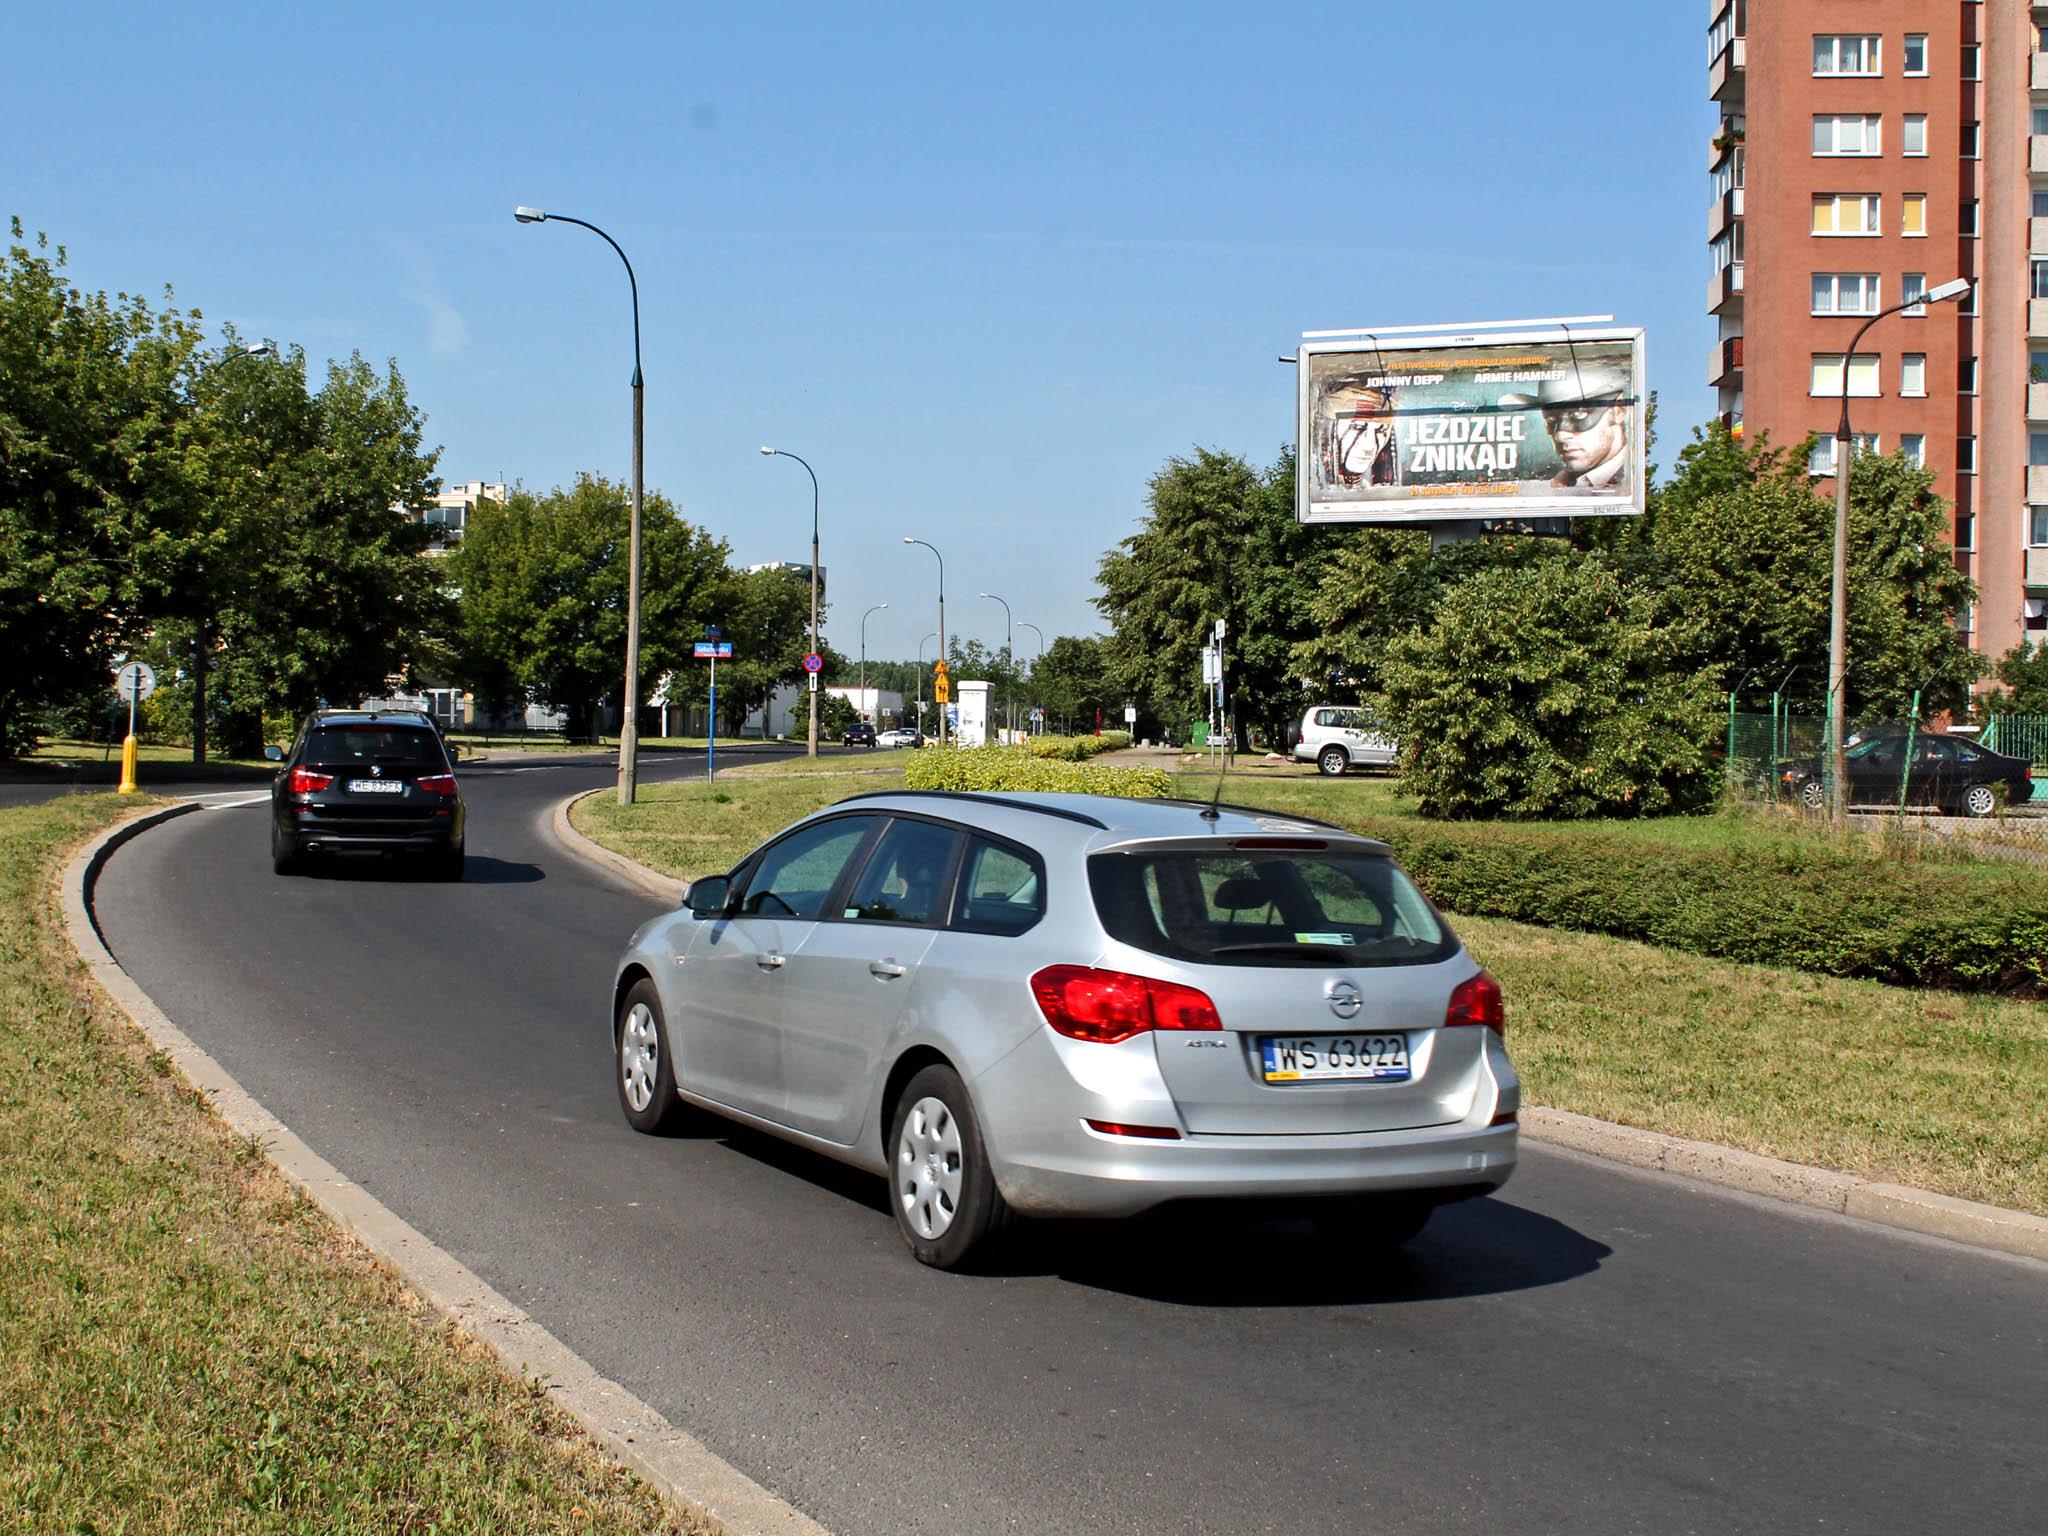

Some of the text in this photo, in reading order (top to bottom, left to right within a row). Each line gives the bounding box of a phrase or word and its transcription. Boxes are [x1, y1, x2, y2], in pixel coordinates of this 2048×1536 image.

[1366, 375, 1444, 387] JOHNNY DEPP
[1474, 370, 1566, 383] ARMIE HAMMER
[1404, 414, 1525, 445] JEŹDZIEC
[1410, 443, 1518, 477] ZNIKĄD
[1184, 1040, 1227, 1049] ASTRA
[1279, 1038, 1403, 1070] WS 63622
